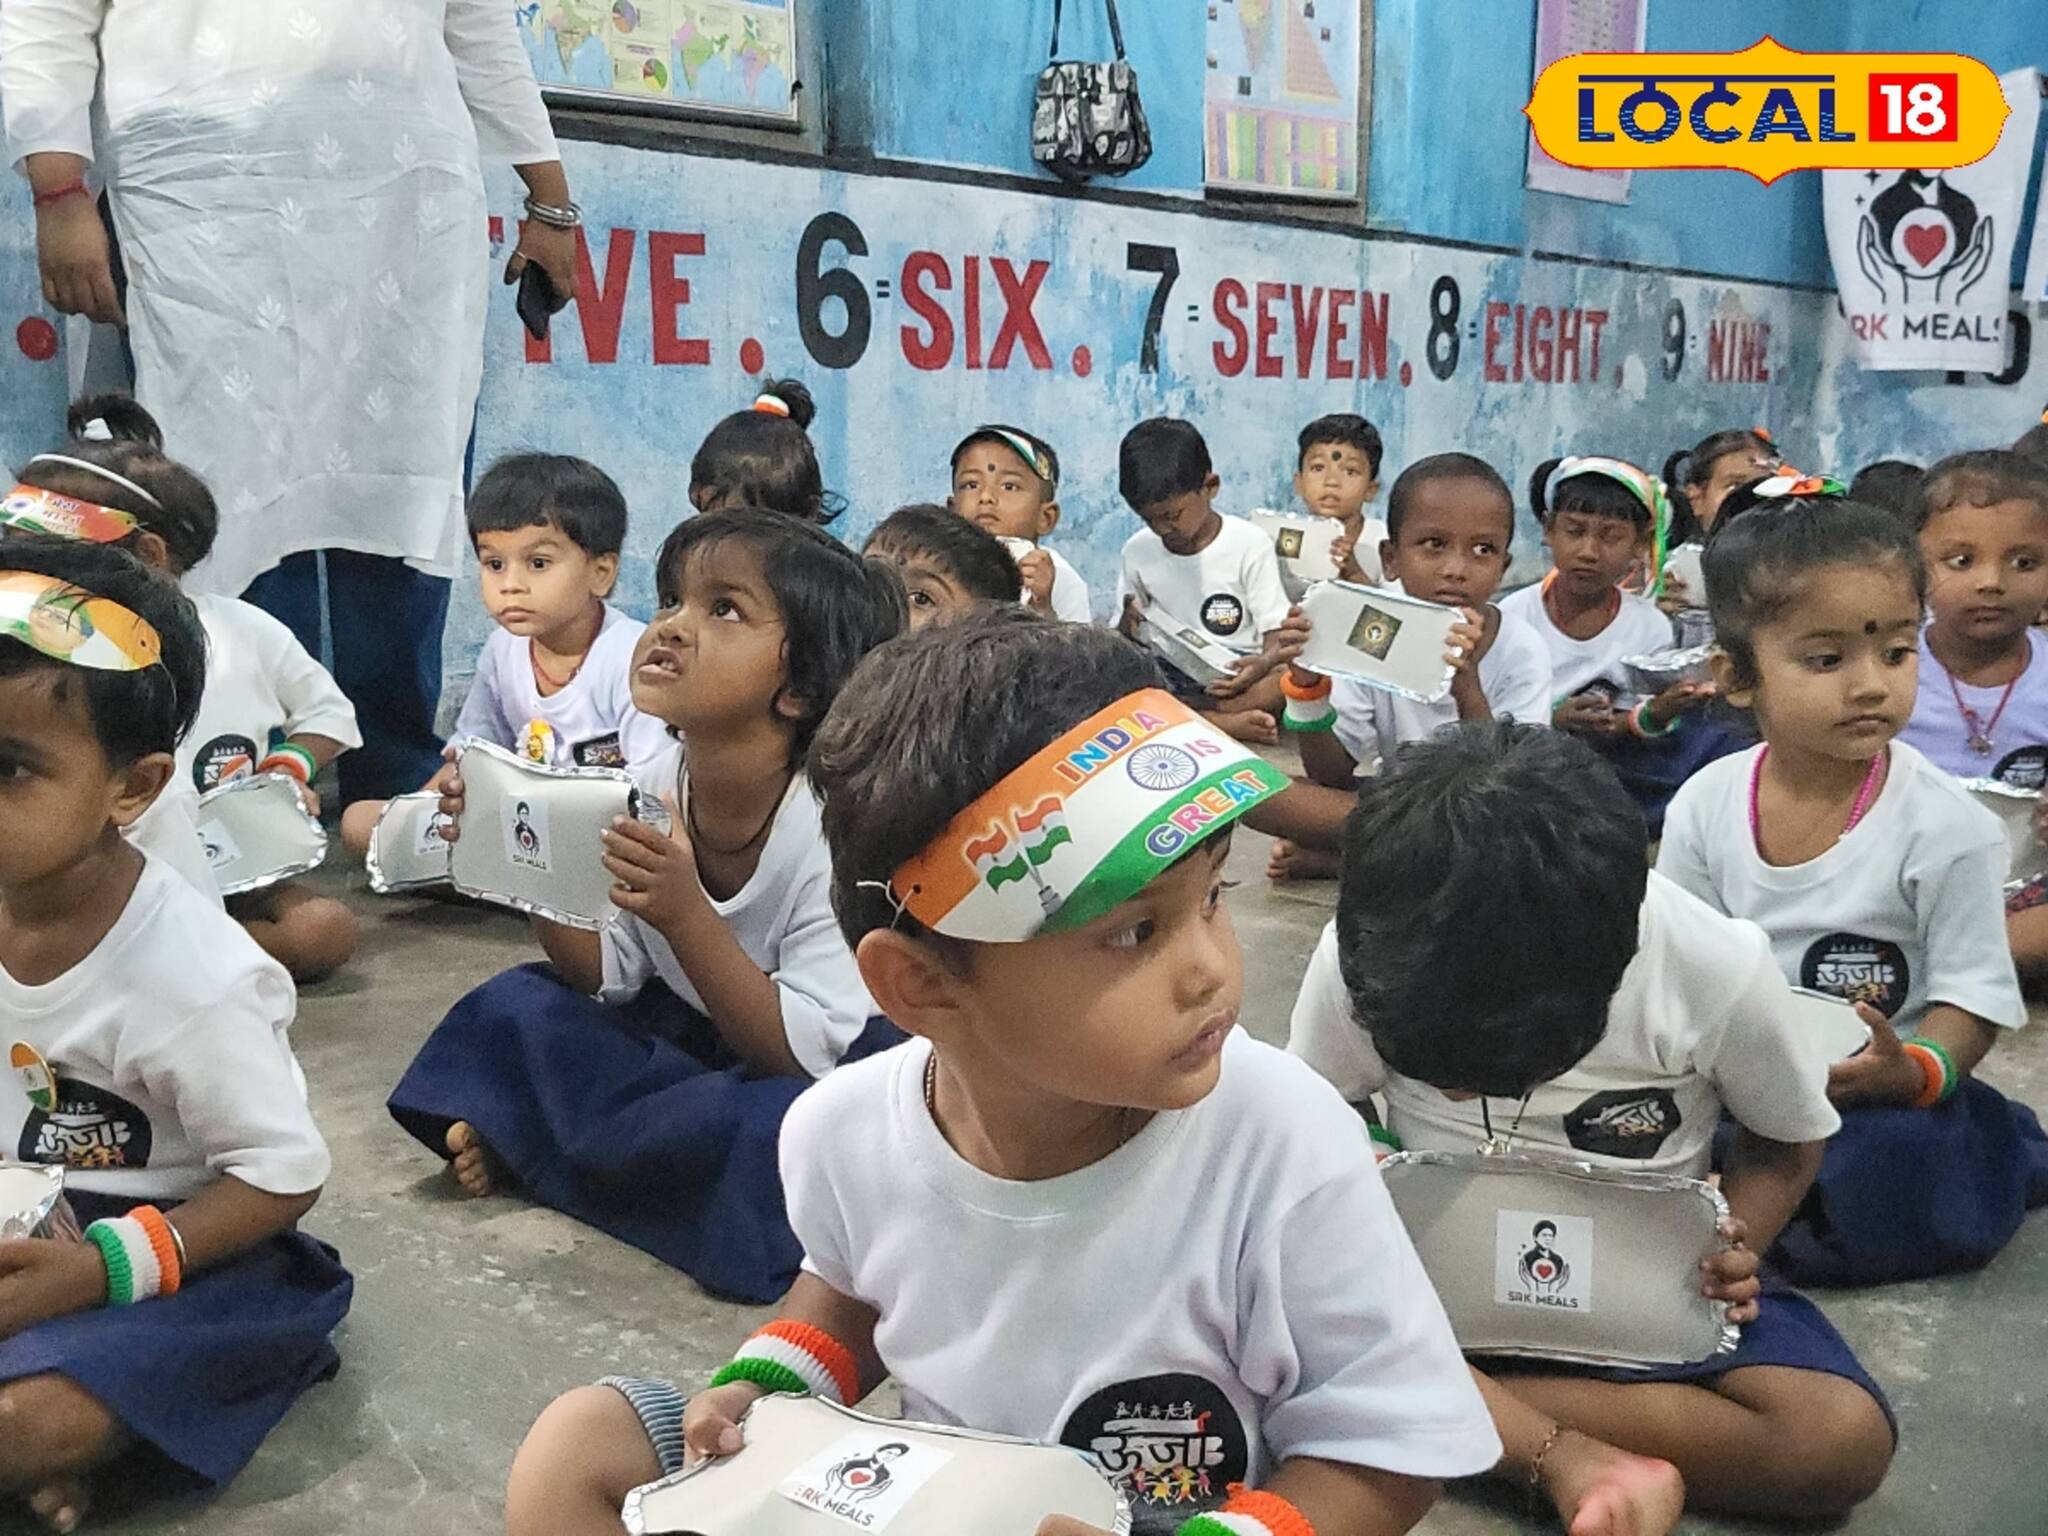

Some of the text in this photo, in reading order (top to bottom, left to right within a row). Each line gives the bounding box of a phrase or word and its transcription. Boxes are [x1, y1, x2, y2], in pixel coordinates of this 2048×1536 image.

[1055, 711, 1167, 782] INDIA
[1184, 738, 1223, 759] IS
[1146, 770, 1267, 856] GREAT
[824, 1496, 876, 1527] MEALS
